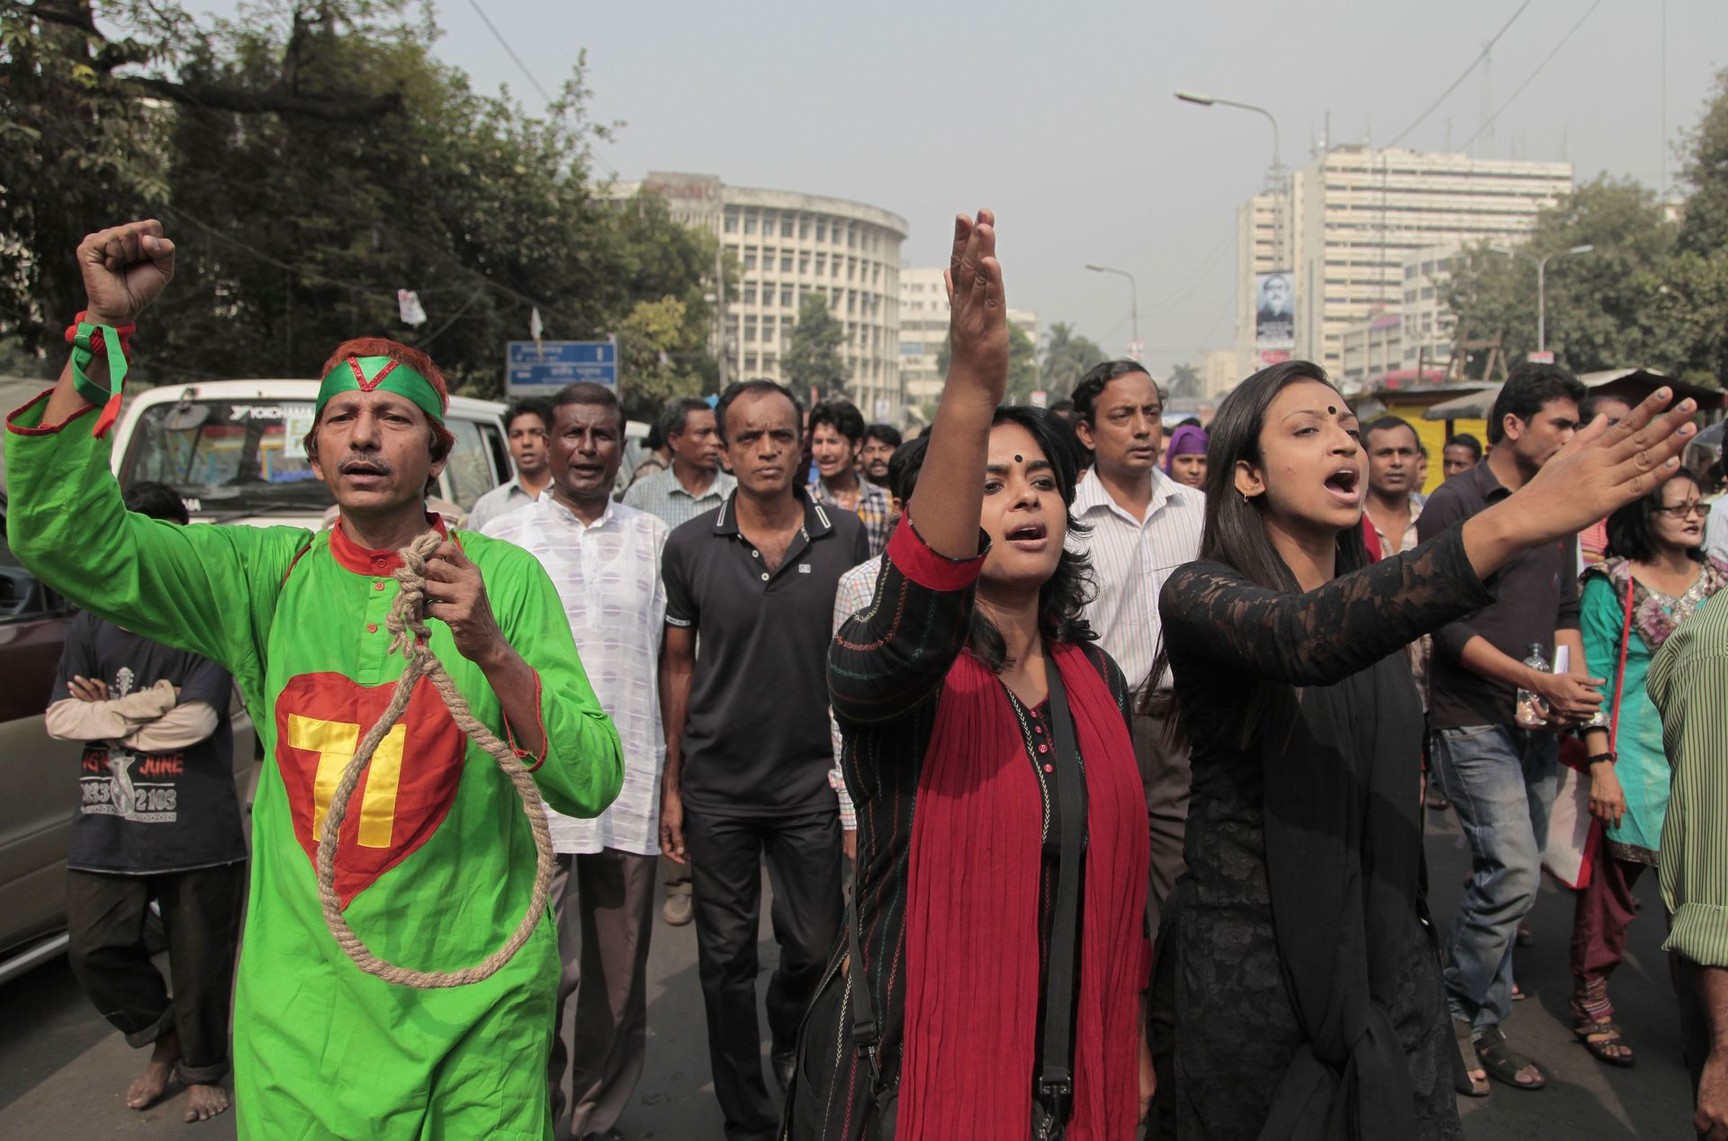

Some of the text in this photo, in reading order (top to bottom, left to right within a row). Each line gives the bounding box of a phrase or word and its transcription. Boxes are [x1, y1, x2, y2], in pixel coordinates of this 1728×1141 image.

[139, 756, 184, 776] JUNE
[288, 714, 407, 848] 71
[135, 789, 177, 811] 2103
